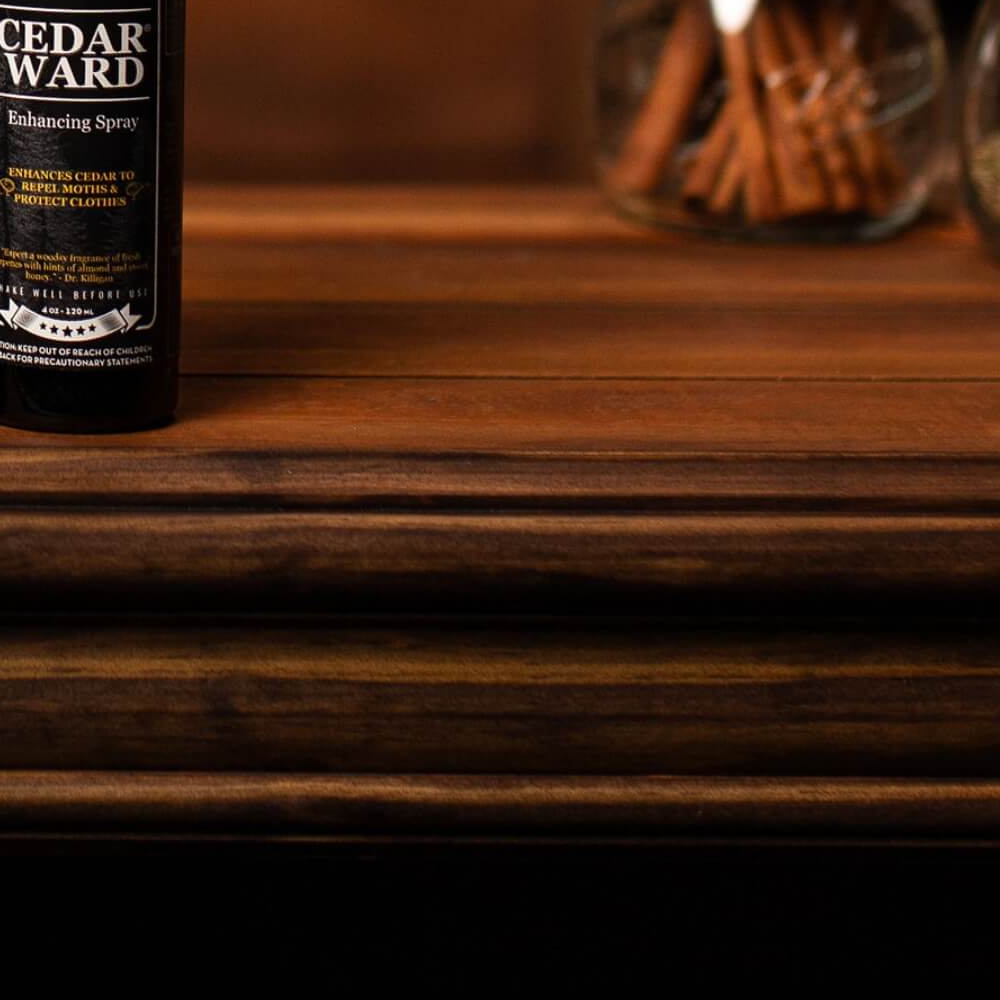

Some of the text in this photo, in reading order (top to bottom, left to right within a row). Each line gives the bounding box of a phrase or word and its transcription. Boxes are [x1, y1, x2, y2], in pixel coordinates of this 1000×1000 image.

[4, 52, 145, 88] WARD
[8, 109, 139, 133] Enhancing Spray
[8, 167, 136, 182] ENHANCES CEDAR TO
[21, 181, 118, 194] REPEL MOTHS &
[13, 193, 127, 208] PROTECT CLOTHES
[24, 261, 41, 270] with
[64, 274, 79, 282] Dr.
[33, 287, 63, 299] WELL
[73, 289, 120, 300] BEFORE
[41, 306, 47, 314] 4
[66, 306, 83, 315] 120
[17, 343, 37, 353] KEEP
[39, 346, 57, 354] OUT
[58, 347, 71, 356] OF
[73, 348, 101, 356] REACH
[103, 347, 114, 356] OF
[116, 345, 152, 355] CHILDREN
[17, 354, 33, 362] FOR
[34, 356, 104, 367] PRECAUTIONARY
[106, 356, 152, 366] STATEMENTS
